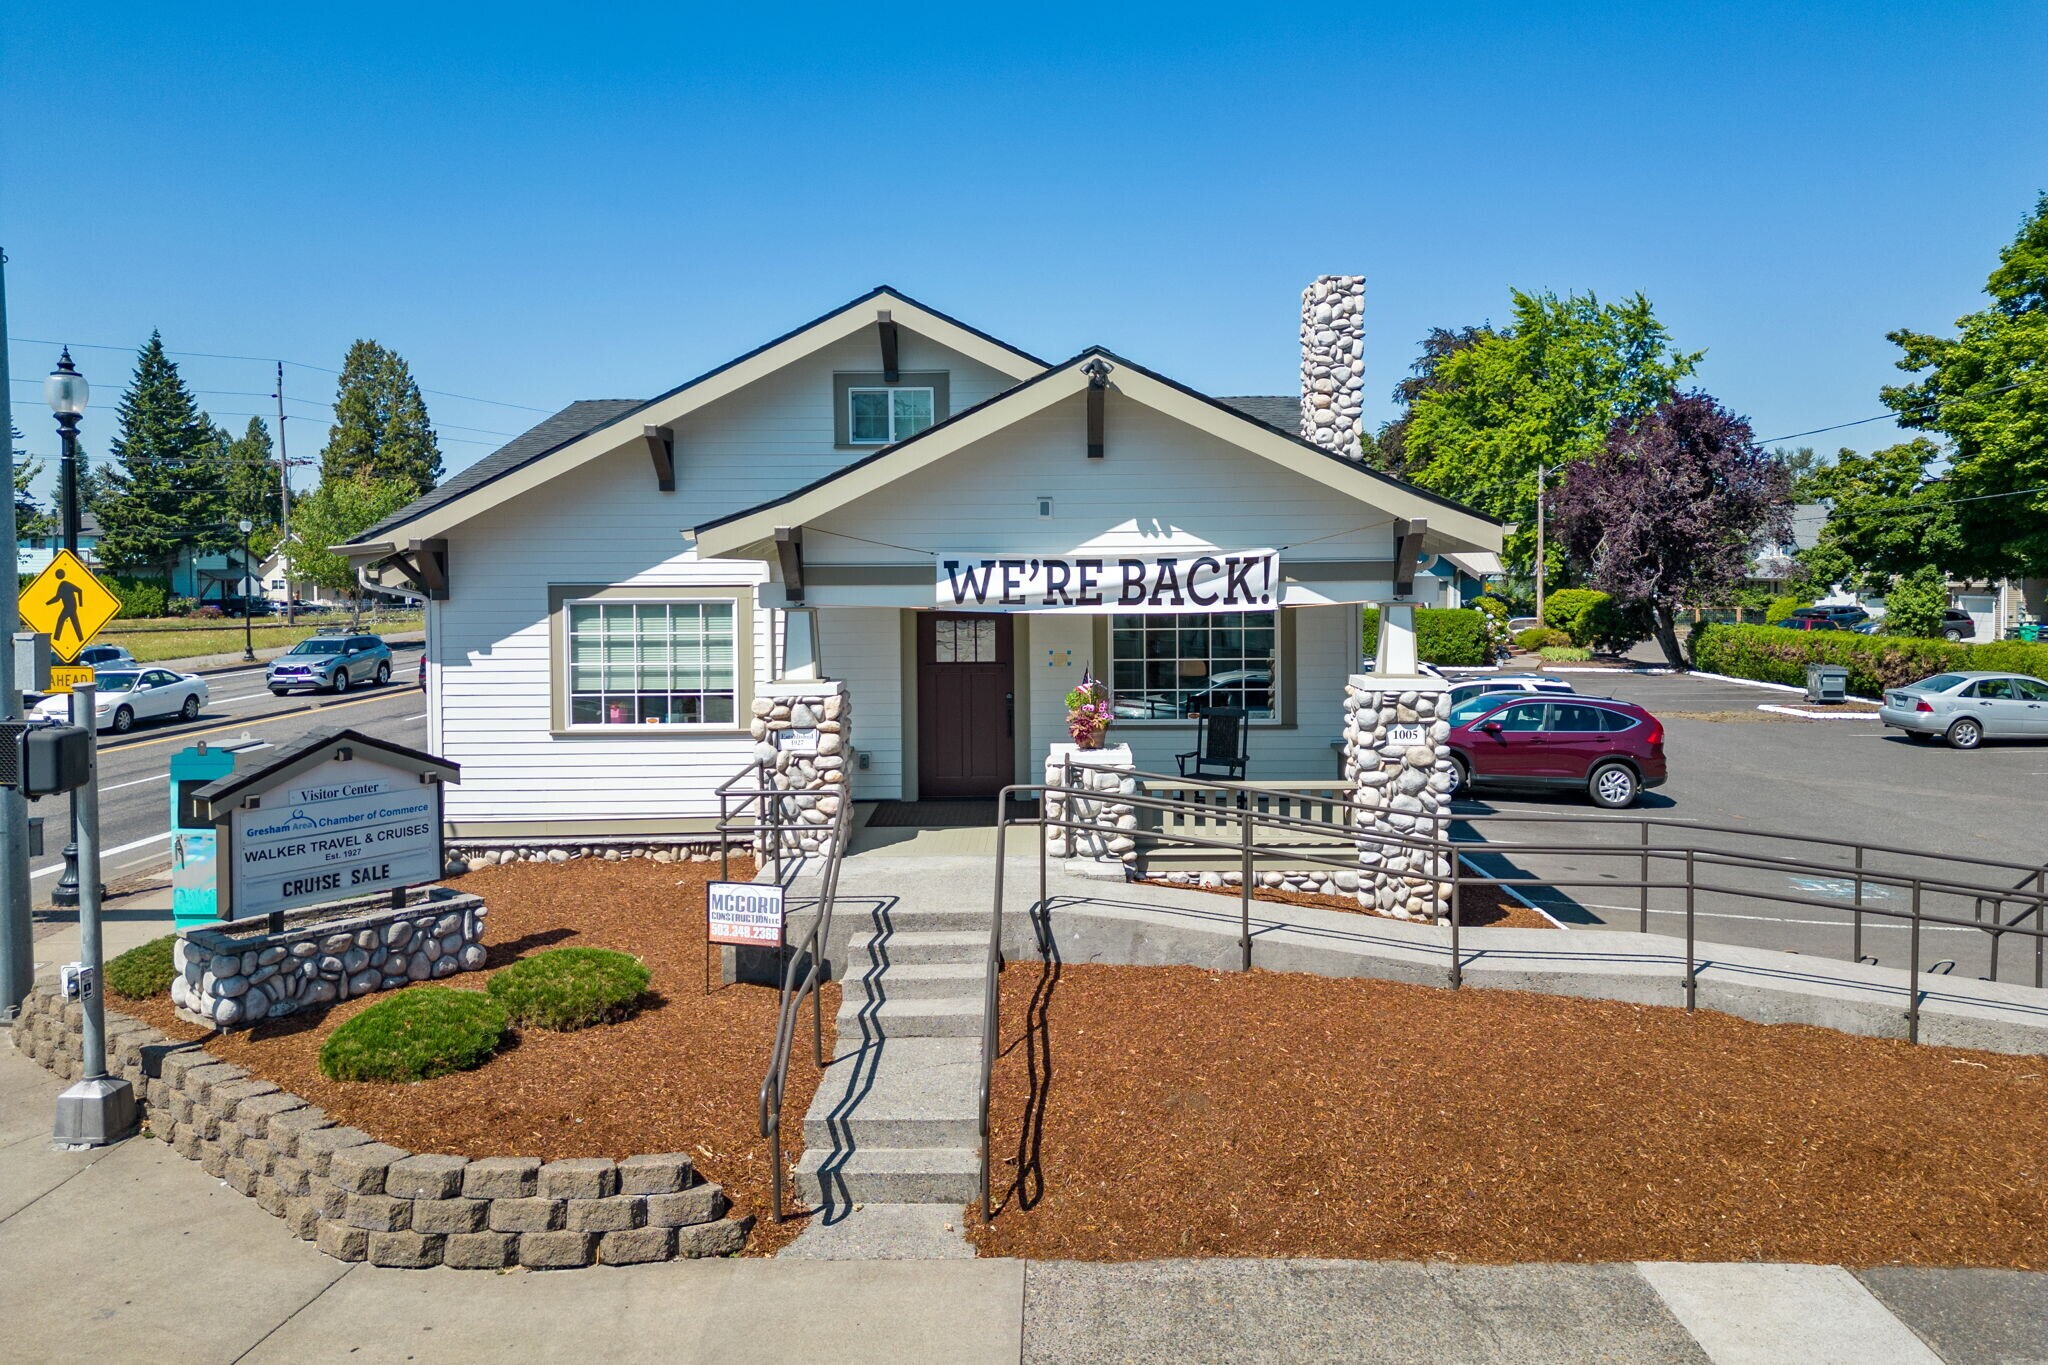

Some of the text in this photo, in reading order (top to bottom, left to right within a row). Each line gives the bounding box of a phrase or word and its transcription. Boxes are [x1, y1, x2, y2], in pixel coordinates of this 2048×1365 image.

[943, 556, 1271, 606] WE'RE BACK!
[51, 674, 88, 687] AHEAD
[1393, 730, 1418, 740] 1005
[301, 783, 379, 802] Visitor Center
[246, 804, 429, 837] Gresham Area Chamber of Commerce
[244, 823, 430, 863] WALKER TRAVEL & CRUISES
[325, 848, 362, 861] Est. 1927
[282, 864, 390, 897] CRUISE SALE
[711, 894, 780, 914] MCCORD
[711, 911, 769, 924] CONSTRUCTION
